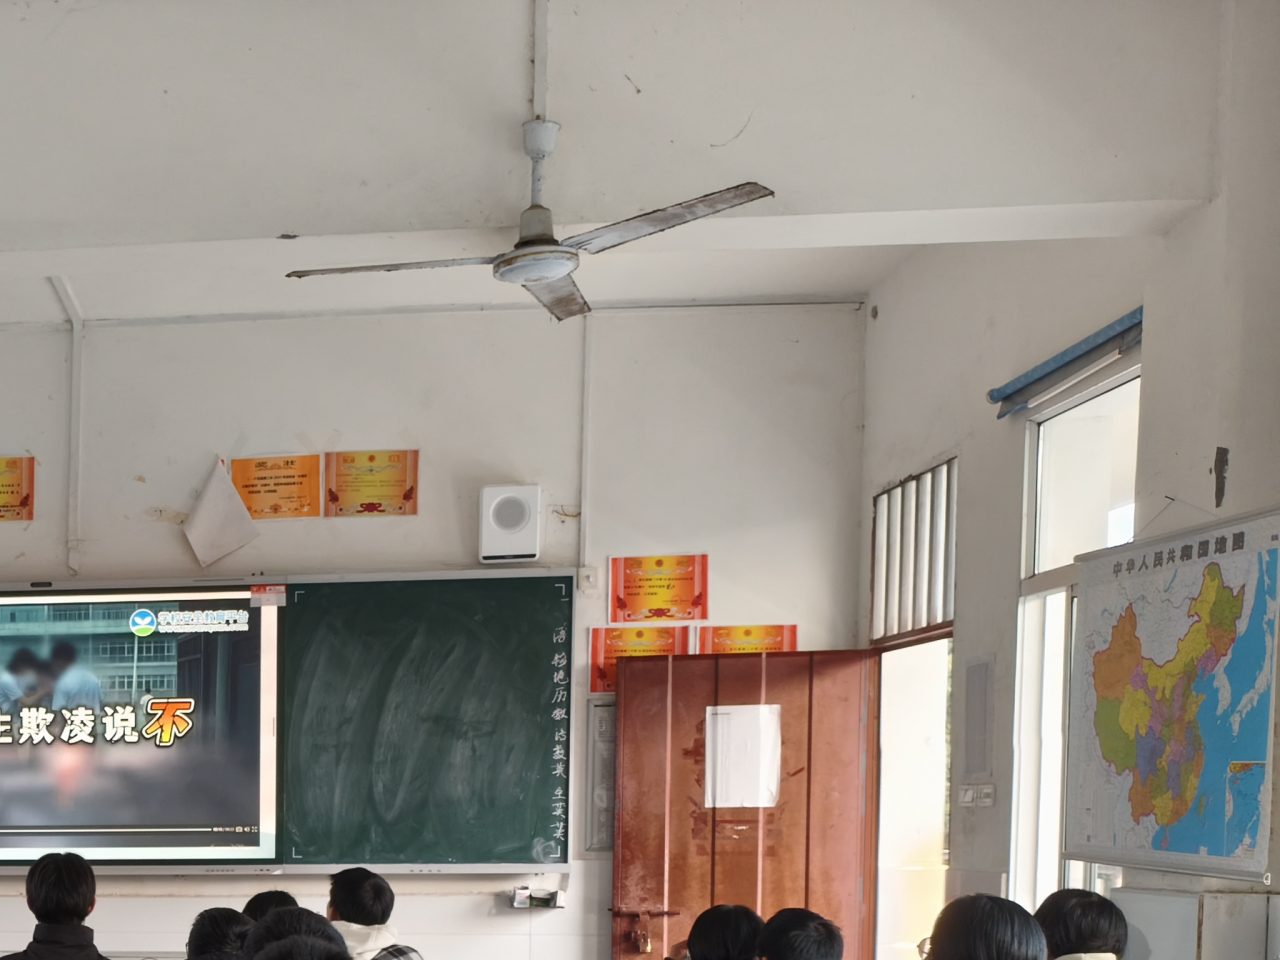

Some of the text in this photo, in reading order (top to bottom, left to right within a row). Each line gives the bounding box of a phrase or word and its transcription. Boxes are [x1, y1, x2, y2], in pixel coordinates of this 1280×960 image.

[1113, 531, 1245, 578] 中华人民共和国地图
